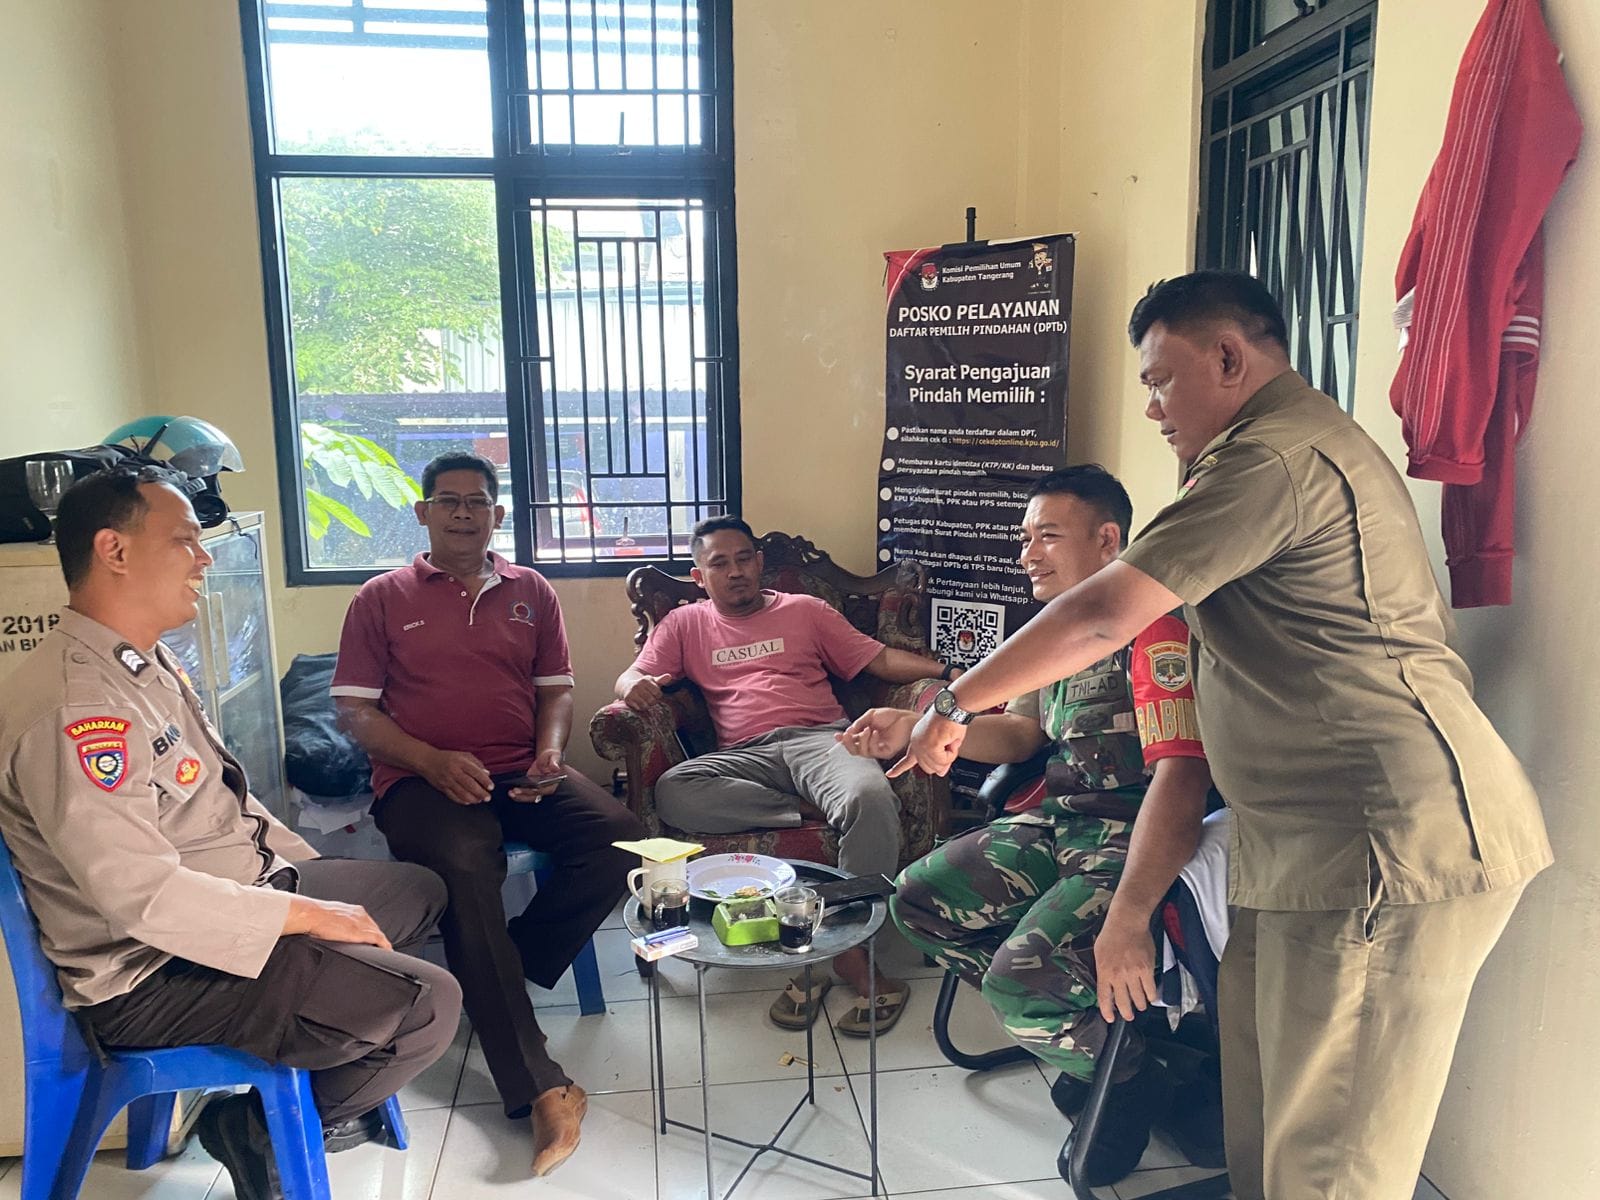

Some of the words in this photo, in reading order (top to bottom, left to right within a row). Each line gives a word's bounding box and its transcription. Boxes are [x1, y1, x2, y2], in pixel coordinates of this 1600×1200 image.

[942, 264, 964, 274] Komisi
[964, 262, 999, 273] Pemilihan
[999, 261, 1022, 270] Umum
[942, 274, 977, 284] Kabupaten
[978, 271, 1014, 281] Tangerang
[899, 305, 951, 322] POSKO
[957, 299, 1060, 320] PELAYANAN
[889, 326, 928, 338] DAFTAR
[929, 325, 970, 337] PEMILIH
[973, 322, 1031, 335] PINDAHAN
[1033, 320, 1067, 335] (DPTb)
[904, 365, 957, 383] Syarat
[960, 363, 1051, 383] Pengajuan
[909, 387, 962, 403] Pindah
[967, 386, 1035, 403] Memilih
[901, 426, 929, 435] Pastikan
[948, 427, 965, 435] anda
[965, 428, 996, 436] terdaftar
[997, 429, 1019, 437] dalam
[1020, 429, 1037, 438] DPT,
[901, 435, 928, 443] silahkan
[898, 457, 933, 466] Membawa
[952, 459, 980, 468] identitas
[981, 461, 1015, 471] (KTP/KK)
[1016, 462, 1029, 471] dan
[1031, 464, 1054, 472] berkas
[896, 467, 937, 476] persyaratan
[938, 468, 961, 477] pindah
[953, 489, 977, 498] pindah
[978, 490, 1011, 499] memilih,
[946, 498, 961, 506] PPK
[962, 499, 978, 507] atau
[979, 499, 995, 507] PPS
[893, 517, 921, 527] Petugas
[921, 519, 935, 527] KPU
[936, 520, 973, 530] Kabupaten,
[975, 522, 991, 530] PPK
[992, 523, 1009, 531] atau
[893, 526, 933, 535] memberikan
[934, 528, 952, 537] Surat
[953, 529, 978, 538] Pindah
[979, 531, 1008, 540] Memilih
[915, 549, 929, 557] Anda
[930, 551, 947, 559] akan
[983, 555, 997, 563] TPS
[971, 563, 985, 571] TPS
[986, 564, 1003, 573] baru
[936, 578, 980, 589] Pertanyaan
[981, 581, 1000, 590] lebih
[926, 587, 954, 598] ubungi
[955, 589, 974, 598] kami
[975, 591, 988, 599] via
[989, 592, 1029, 604] Whatsapp
[716, 641, 780, 663] CASUAL
[1071, 675, 1119, 695] TNI-AD
[71, 721, 125, 736] BAHARKAM
